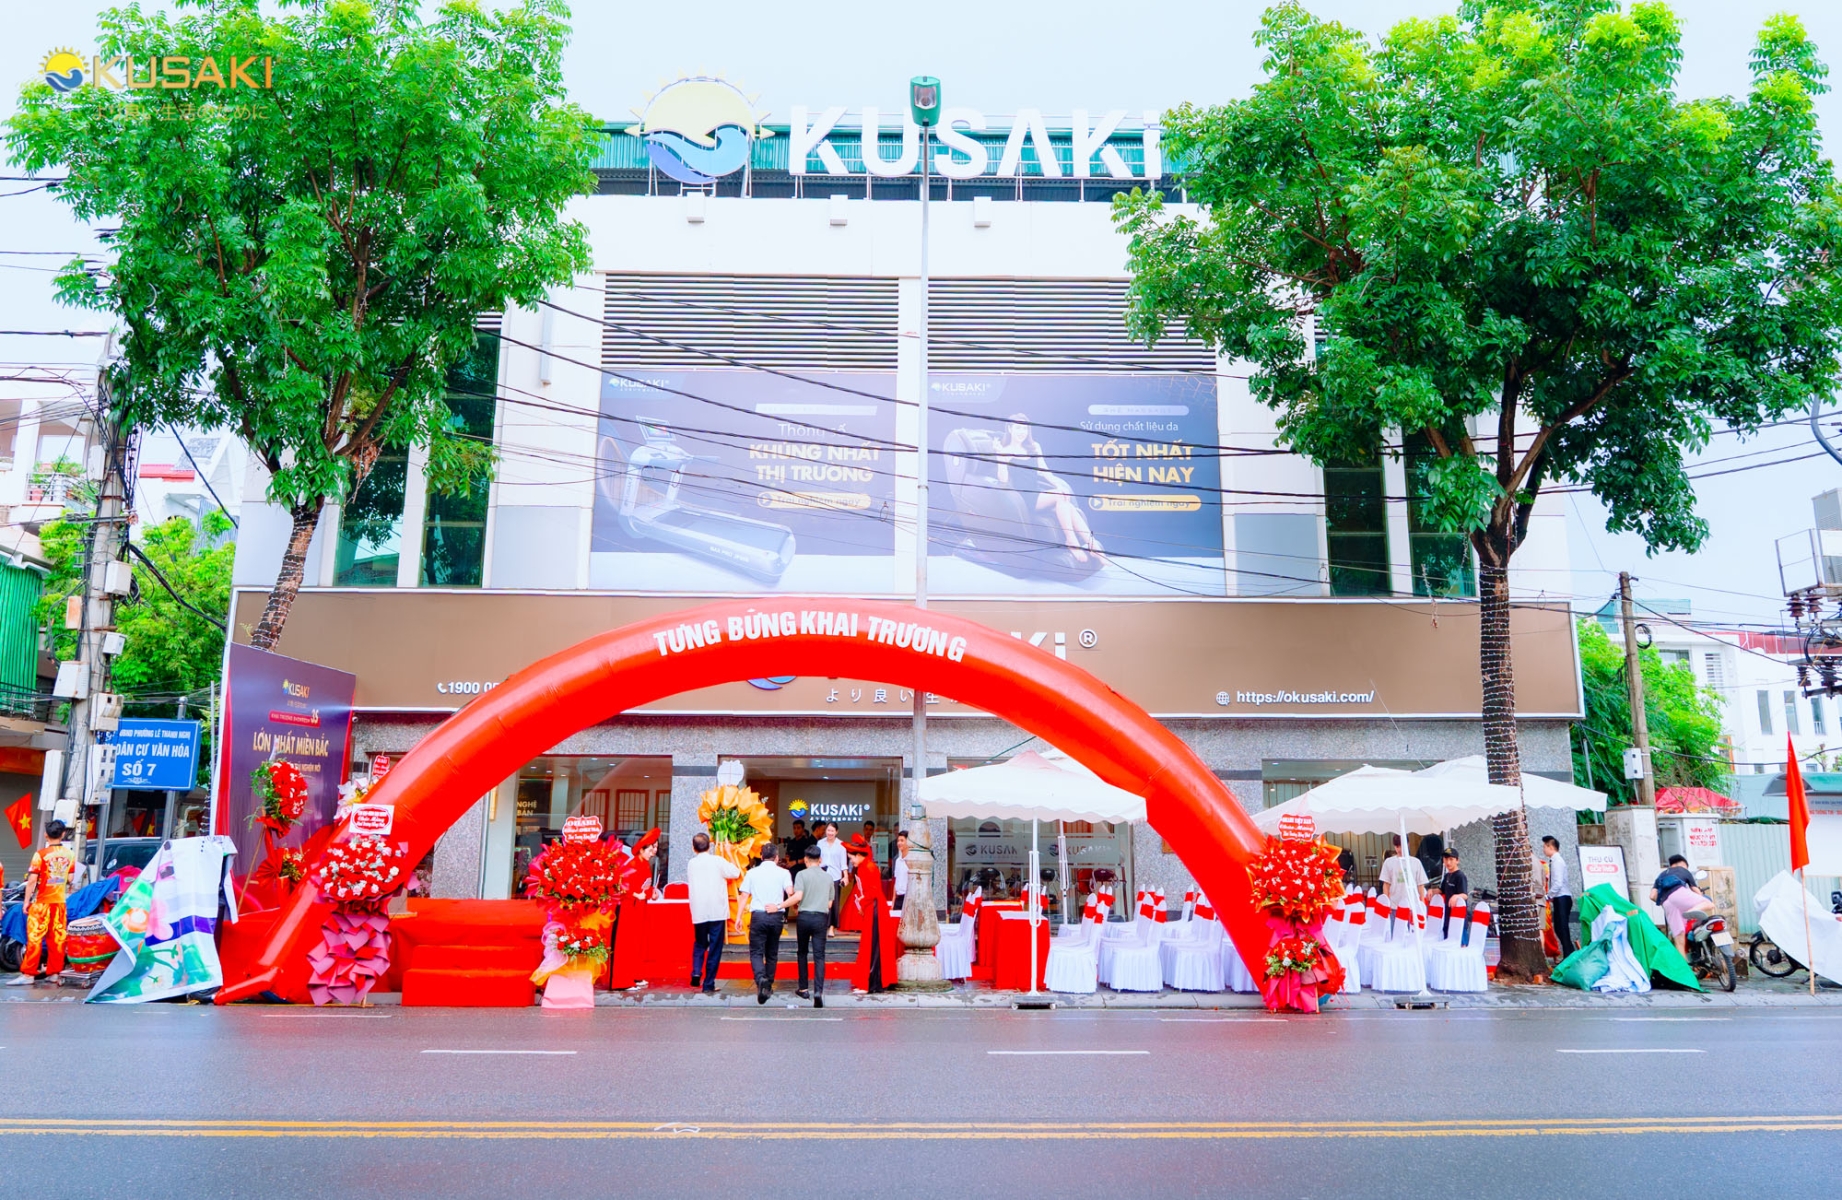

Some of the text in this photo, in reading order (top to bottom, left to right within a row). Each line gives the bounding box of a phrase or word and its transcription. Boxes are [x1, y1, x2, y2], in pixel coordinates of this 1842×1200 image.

[942, 383, 986, 391] KUSAKI
[1095, 421, 1120, 432] dụng
[1123, 421, 1144, 431] chất
[1146, 421, 1164, 432] liệu
[1166, 421, 1179, 431] da
[1091, 439, 1194, 461] TỐT NHẤT
[756, 465, 786, 484] THỊ
[1093, 463, 1194, 487] HIỆN NAY
[801, 611, 858, 637] KHAI
[288, 683, 310, 698] KUSAKI
[448, 682, 480, 694] 1900
[1236, 690, 1374, 705] https://okusaki.com/
[253, 727, 271, 752] LỚN
[136, 743, 150, 756] CƯ
[152, 743, 170, 757] VĂN
[171, 743, 190, 758] HÓA
[122, 759, 156, 776] SỐ 7
